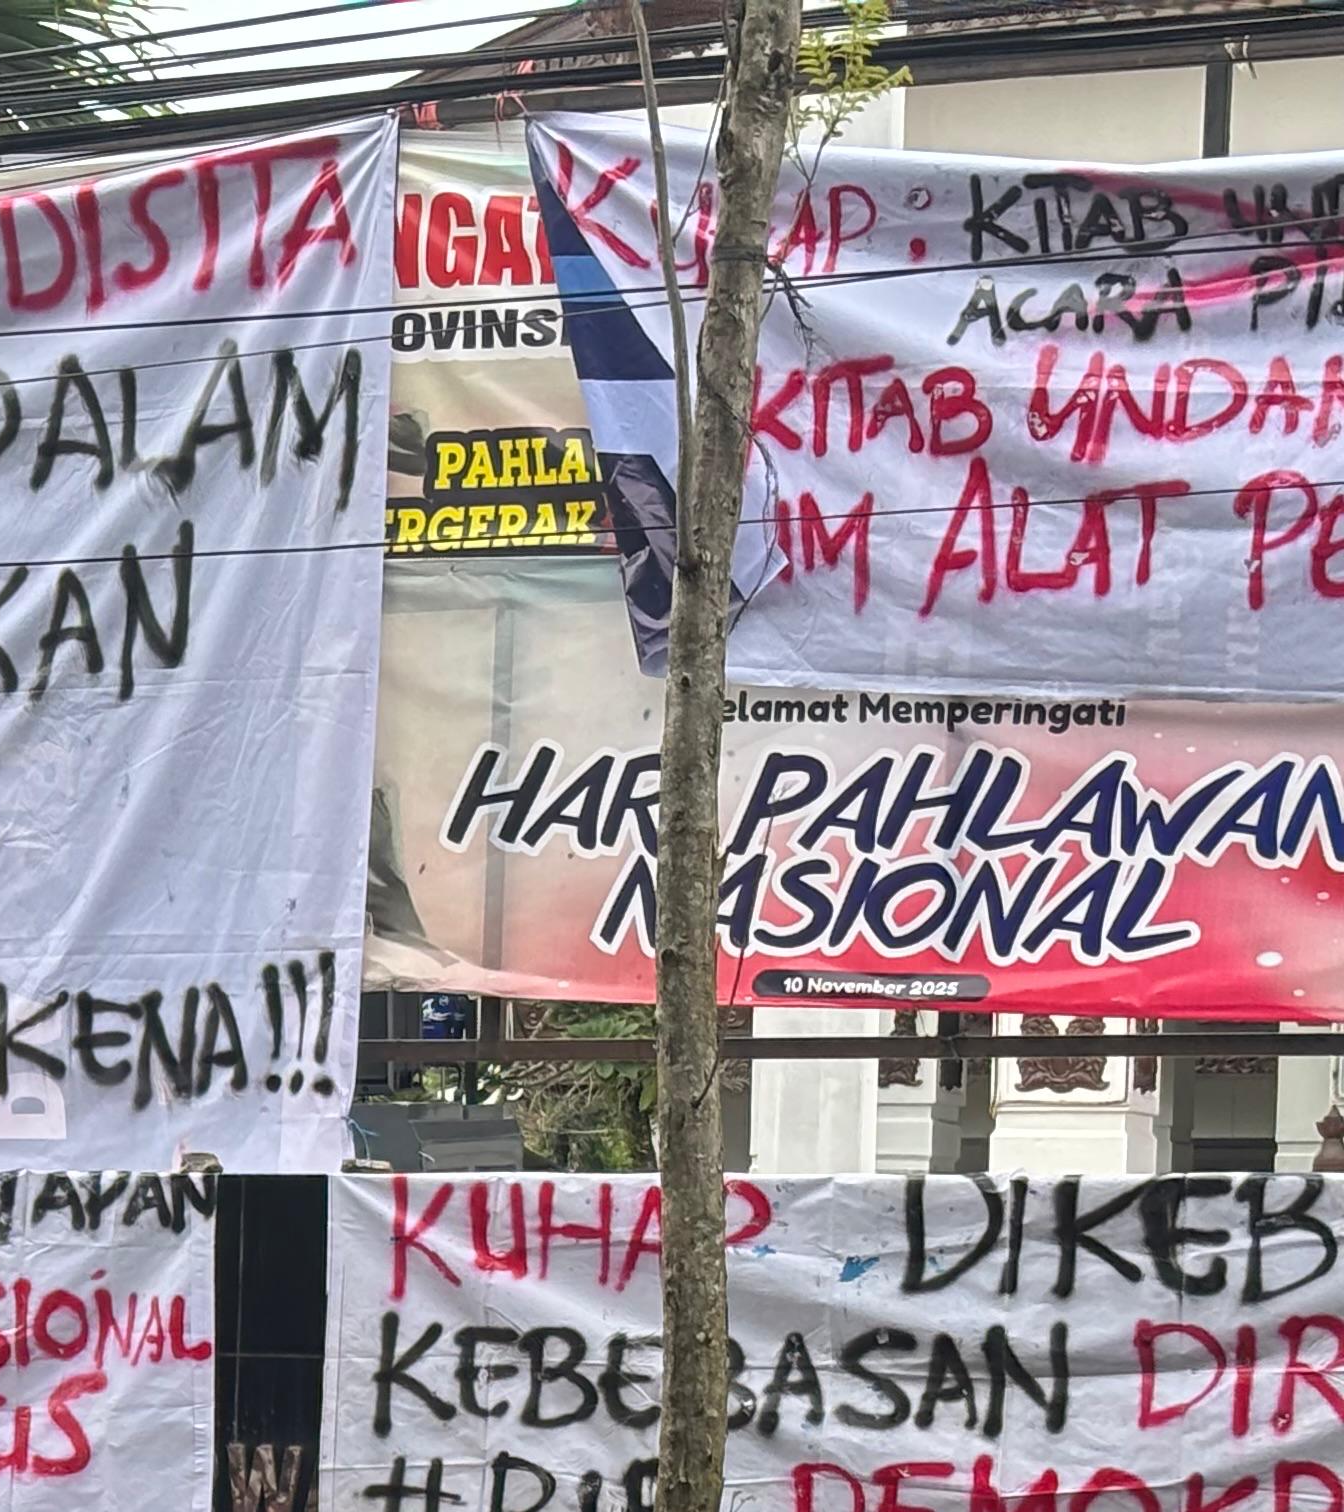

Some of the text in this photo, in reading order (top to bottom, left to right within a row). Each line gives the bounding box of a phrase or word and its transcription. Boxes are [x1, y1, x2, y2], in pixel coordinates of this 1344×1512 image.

[559, 142, 876, 290] KUAP
[963, 173, 1189, 262] KITAB
[947, 250, 1344, 346] ACARA PI
[434, 437, 602, 490] PAHLA
[919, 456, 1191, 620] ALAT
[722, 690, 1127, 734] elamat Memperingati
[783, 977, 960, 996] 10 November 2025
